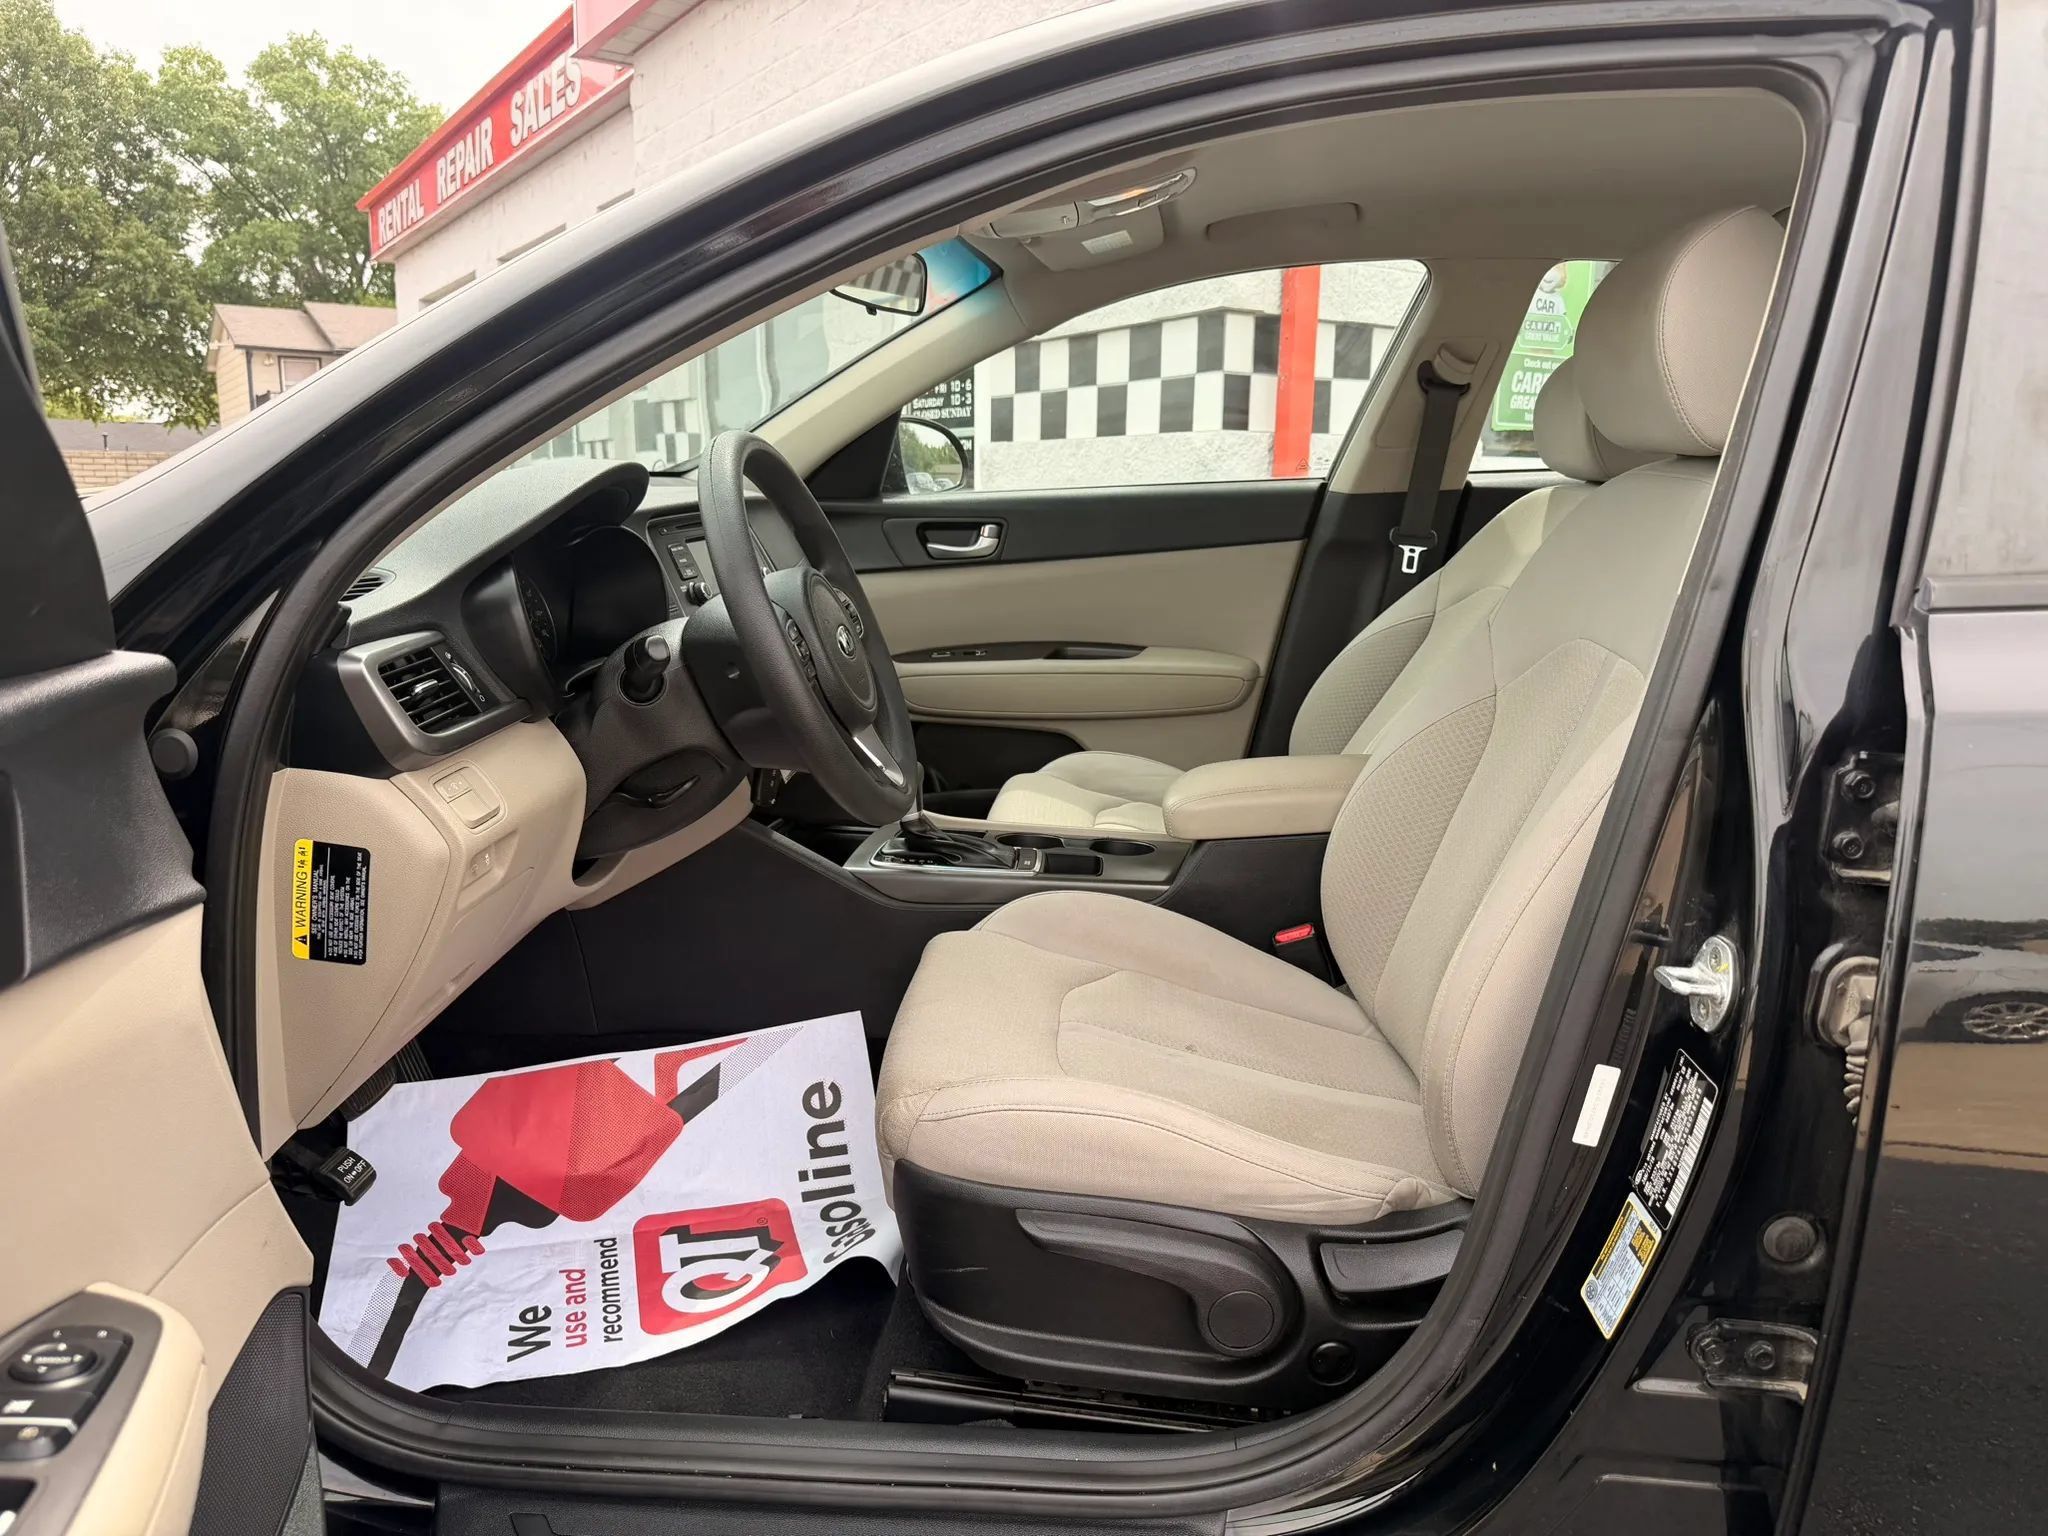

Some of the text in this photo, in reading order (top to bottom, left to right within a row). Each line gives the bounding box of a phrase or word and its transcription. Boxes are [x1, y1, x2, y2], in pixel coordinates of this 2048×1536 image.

[377, 51, 583, 247] RENTAL REPAIR SALES
[912, 397, 944, 410] SATURDAY
[941, 406, 972, 419] SUNDAY
[295, 871, 308, 928] WARNING
[337, 1156, 355, 1174] PUSH
[798, 1079, 877, 1264] Gasoline
[593, 1237, 623, 1344] recommend
[659, 1225, 785, 1314] QT
[506, 1305, 552, 1362] We
[558, 1268, 588, 1348] use and
